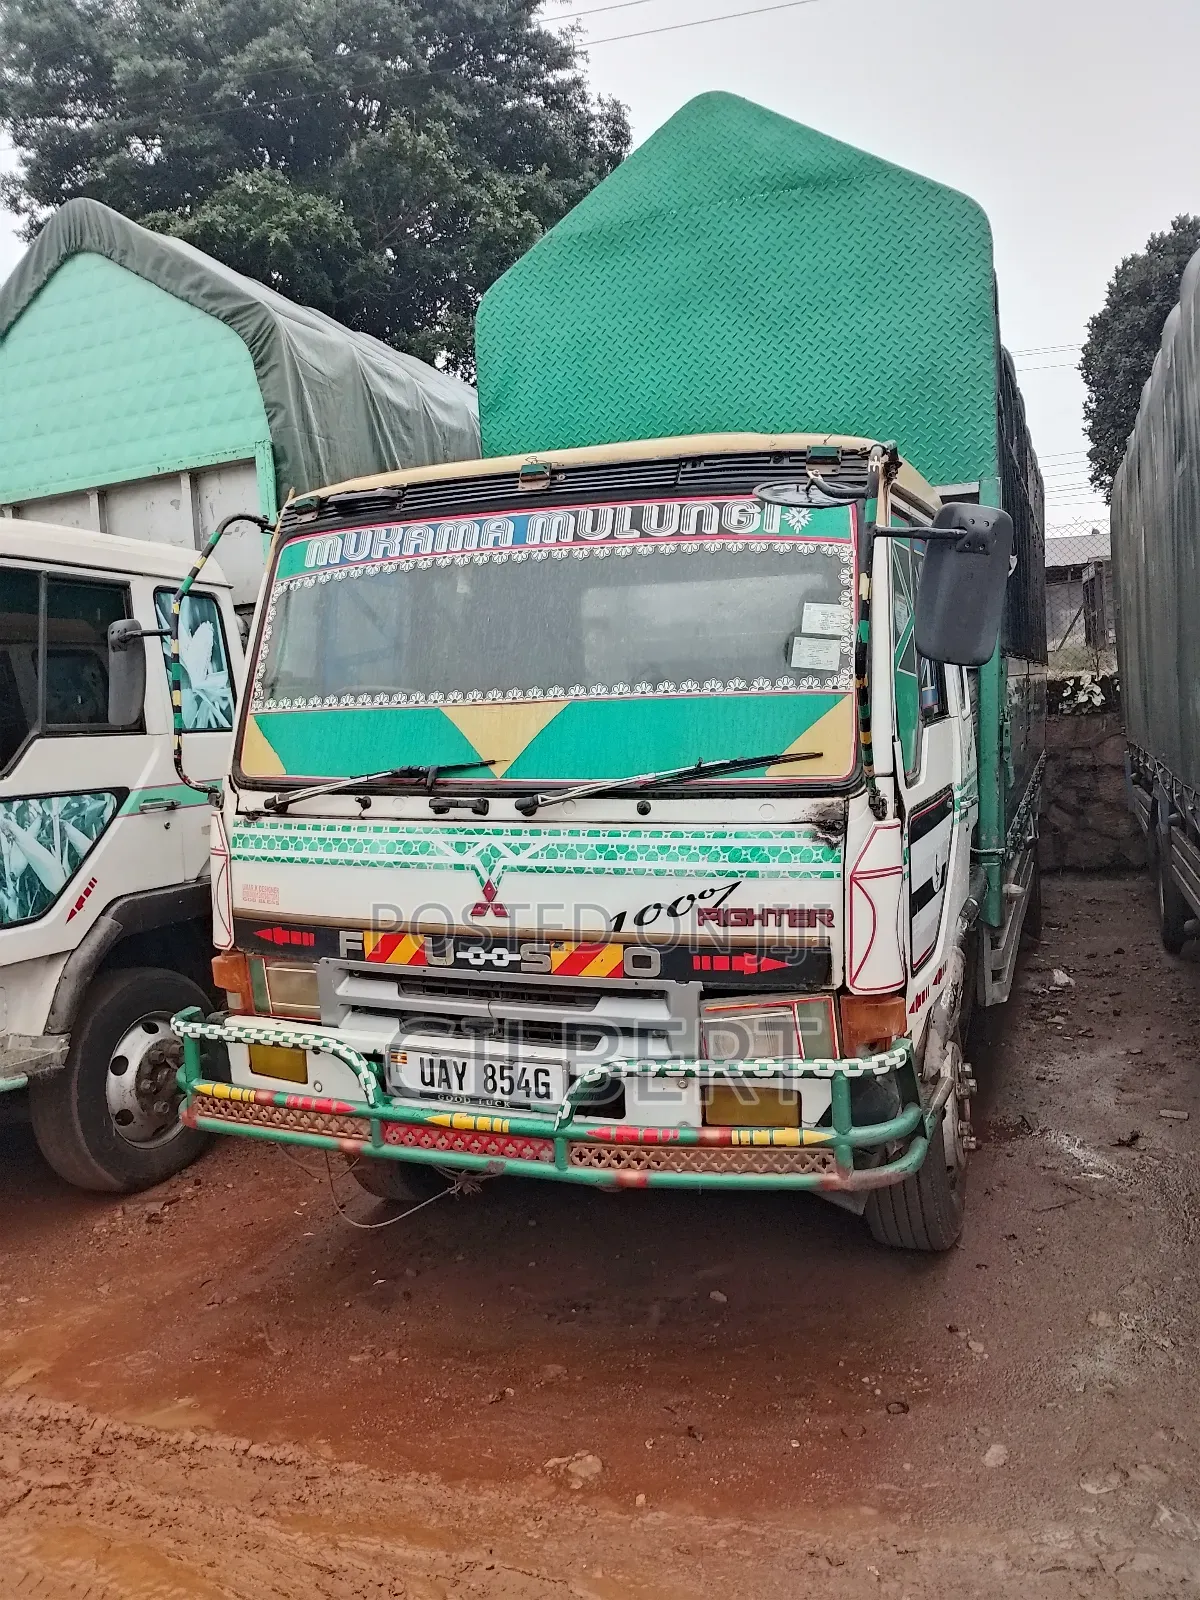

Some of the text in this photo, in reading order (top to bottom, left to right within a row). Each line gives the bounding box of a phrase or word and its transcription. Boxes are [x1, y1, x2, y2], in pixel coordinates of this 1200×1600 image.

[304, 500, 782, 567] MUKAMA MULUNGI
[697, 907, 835, 928] FIGHTER
[419, 1056, 551, 1099] UAY 854G
[437, 1094, 511, 1108] GOOD LUCK
